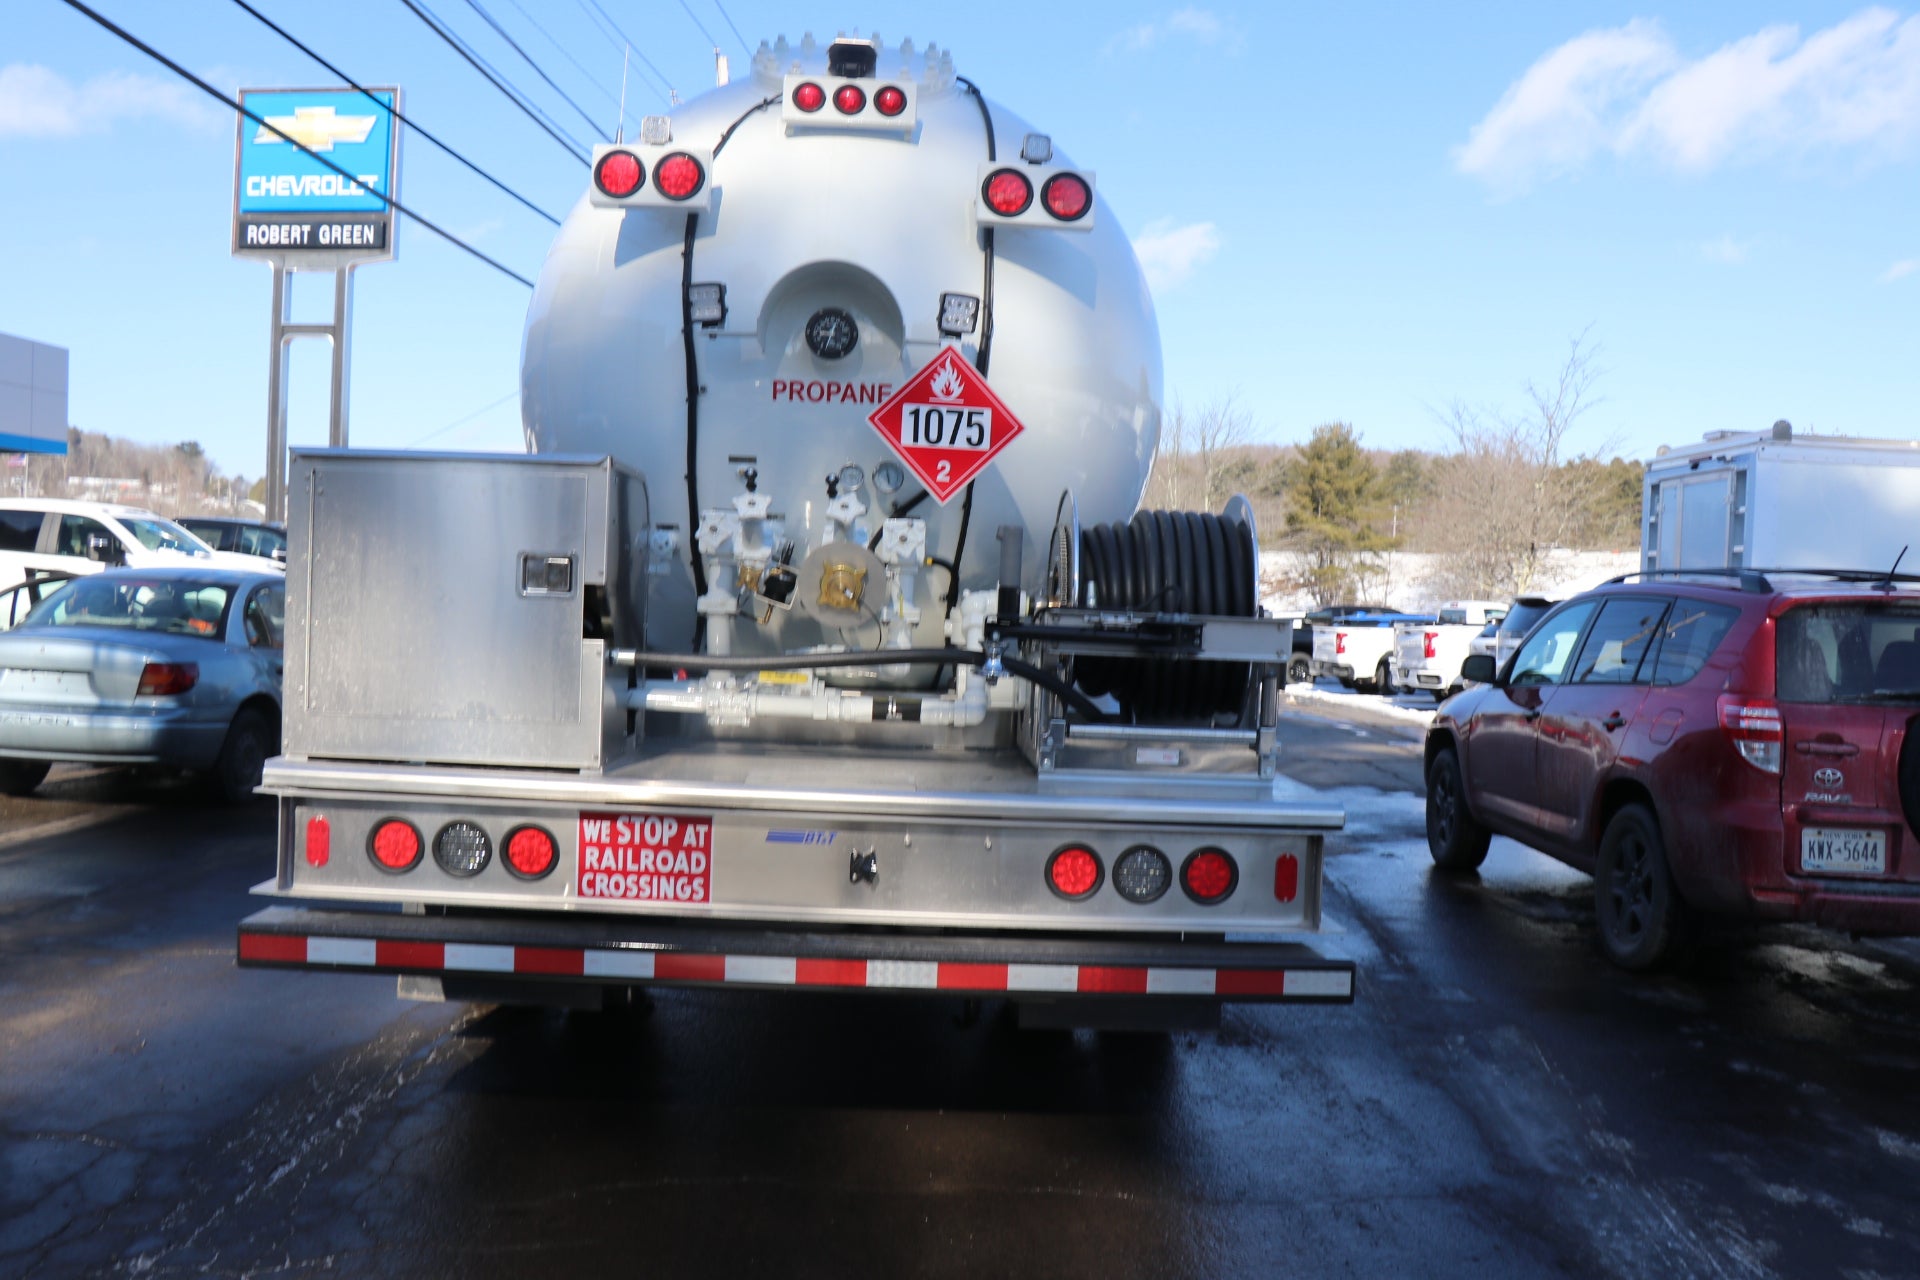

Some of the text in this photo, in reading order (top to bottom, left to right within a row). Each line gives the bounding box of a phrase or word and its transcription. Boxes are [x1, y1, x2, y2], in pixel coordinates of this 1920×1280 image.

[246, 174, 379, 197] CHEVROLET
[247, 224, 375, 244] ROBERT GREEN
[772, 380, 893, 404] PROPANE
[908, 408, 985, 447] 1075
[936, 460, 951, 483] 2
[583, 816, 708, 848] WE STOP AT
[585, 846, 706, 875] RAILROAD
[581, 872, 705, 901] CROSSINGS
